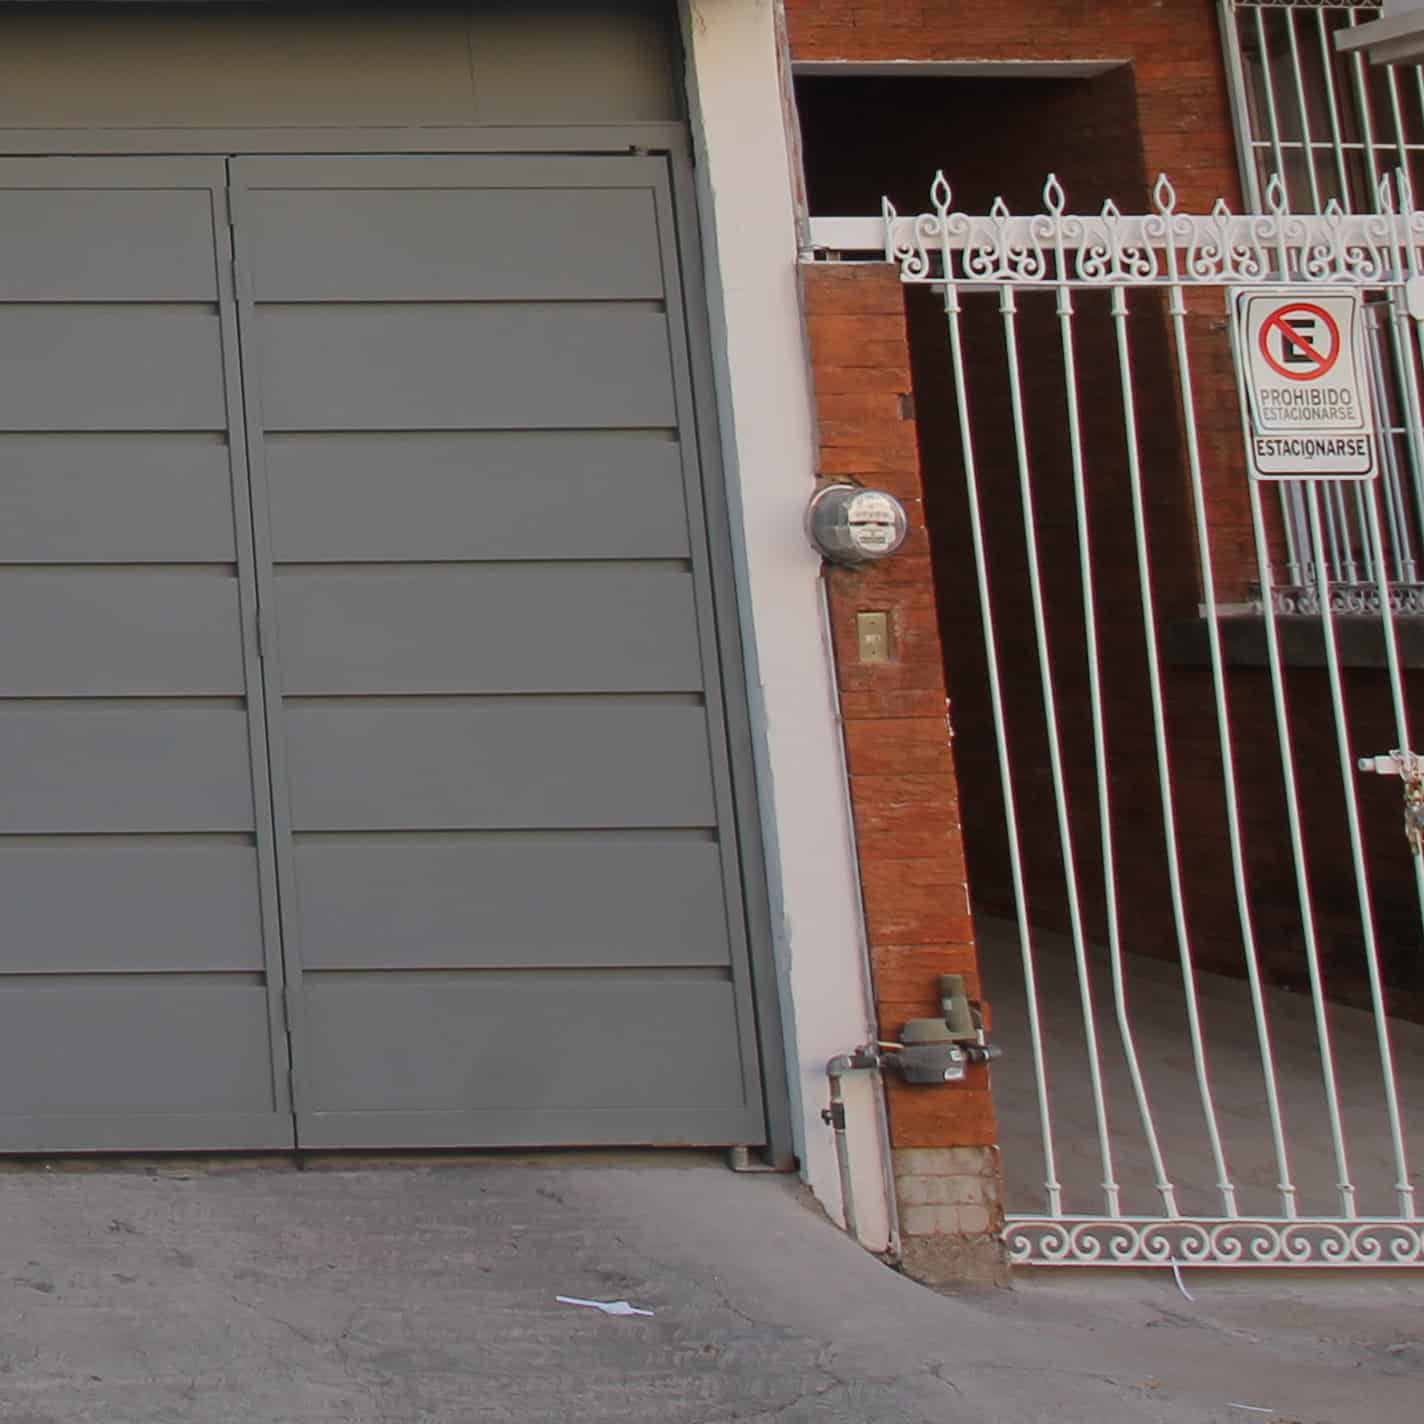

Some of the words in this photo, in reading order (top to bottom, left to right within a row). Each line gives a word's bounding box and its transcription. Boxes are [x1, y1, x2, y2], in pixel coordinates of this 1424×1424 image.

[1259, 387, 1352, 407] PROHIBIDO
[1263, 406, 1356, 421] ESTACIONARSE
[1255, 438, 1366, 457] ESTACIONARSE
